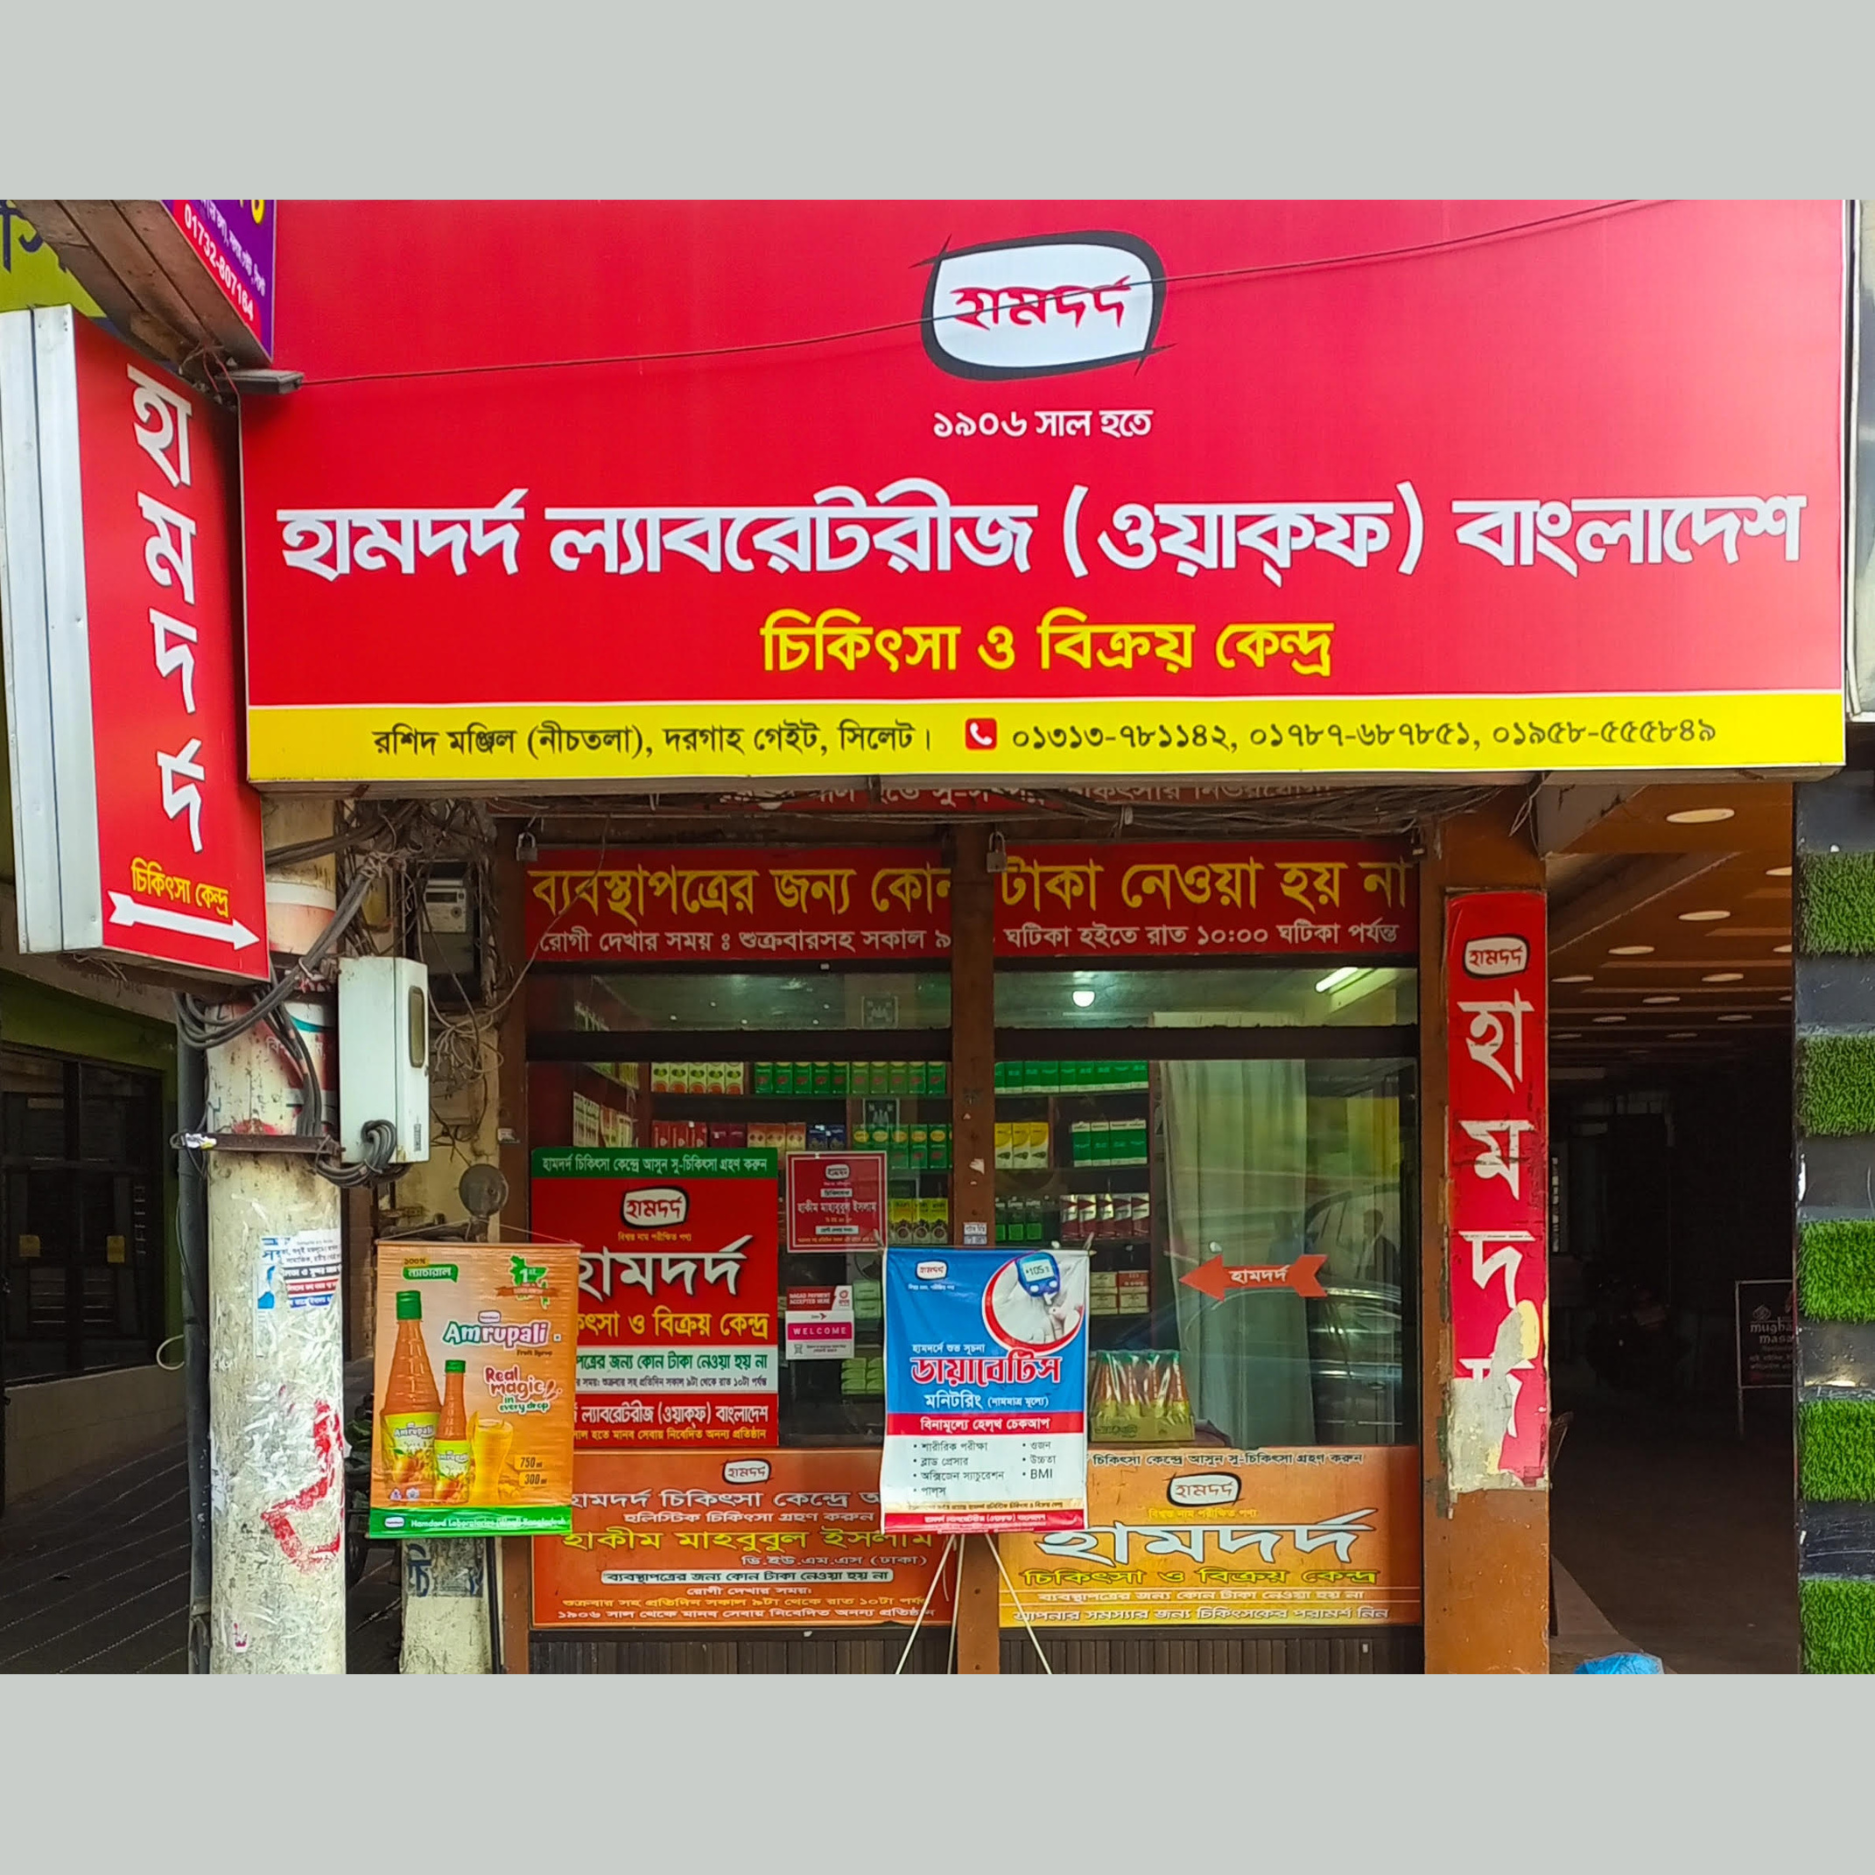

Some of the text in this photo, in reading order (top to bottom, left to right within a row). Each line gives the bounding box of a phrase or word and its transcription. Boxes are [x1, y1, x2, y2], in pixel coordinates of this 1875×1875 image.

[950, 275, 1131, 331] হামদর্দ
[933, 410, 1153, 438] ১৯০৬ সাল হতে
[277, 488, 529, 581] হামদর্দ
[545, 477, 1038, 574] ল্যাবরেটরীজ
[1452, 495, 1807, 577] বাংলাদেশ
[761, 607, 1334, 677] চিকিৎসা ও বিক্রয় কেন্দ্র
[371, 722, 440, 755] রশিদ
[446, 722, 518, 755] মঞ্জিল
[527, 720, 653, 760] (নীচতলা),
[662, 724, 745, 756] দরগাহ
[753, 719, 828, 756] গেইট,
[1012, 724, 1238, 753] ০১৩১৩-৭৮১১৪২,
[1250, 722, 1481, 751] ০১৭৮৭-৬৮৭৮৫১,
[1493, 719, 1716, 746] ০১৯৫৮-৫৫৫৮৪৯
[131, 857, 229, 918] চিকিৎসা কেন্দ্র
[528, 863, 759, 926] ব্যবস্থাপত্রের
[769, 868, 857, 915] জন্য
[1000, 856, 1411, 914] টাকা নেওয়া হয় না
[539, 926, 591, 953] রোগী
[599, 931, 658, 953] দেখার
[667, 931, 713, 953] সময়
[739, 930, 856, 954] শুক্রবারসহ
[861, 930, 926, 951] সকাল
[1004, 917, 1399, 950] ঘটিকা হইতে রাত ১০:০০ ঘটিকা পর্যন্ত
[1468, 946, 1523, 967] হামদর্দ
[626, 1197, 682, 1219] হামদর্দ
[1228, 1264, 1291, 1284] হামদর্দ
[628, 1305, 770, 1339] ও বিক্রয় কেন্দ্র
[793, 1326, 847, 1336] WELCOME
[444, 1322, 549, 1348] Amrupali
[608, 1351, 768, 1370] জন্য কোন টাকা নেওয়া হয় না
[910, 1346, 1063, 1386] ডায়াবেটিস
[485, 1367, 518, 1381] Real
[491, 1377, 545, 1398] magic
[500, 1402, 549, 1412] every drop
[923, 1389, 983, 1410] মনিটরিং
[581, 1400, 655, 1424] ল্যাবরেটরীজ
[715, 1405, 769, 1425] বাংলাদেশ
[920, 1416, 970, 1434] বিনামূল্যে
[1006, 1418, 1050, 1430] চেকআপ
[921, 1440, 988, 1452] শারীরিক পরীক্ষা
[520, 1457, 536, 1468] 750
[1093, 1453, 1363, 1466] চিকিৎসা কেন্দ্রে আসুন সু-চিকিৎসা গ্রহণ করুন
[524, 1474, 540, 1485] 300
[728, 1465, 767, 1479] হামদর্দ
[1030, 1469, 1053, 1480] BMI
[571, 1488, 653, 1508] হামদর্দ
[660, 1488, 764, 1508] চিকিৎসা
[773, 1491, 851, 1508] কেন্দ্রে
[1175, 1482, 1234, 1498] হামদর্দ
[624, 1511, 874, 1523] হলিস্টিক চিকিৎসা গ্রহণ করুন
[561, 1526, 664, 1551] হাকীম
[674, 1531, 810, 1553] মাহবুবুল
[820, 1525, 932, 1548] ইসলাম
[1036, 1508, 1379, 1567] হামদর্দ
[870, 1555, 927, 1566] (ঢাকা)
[691, 1572, 722, 1582] জন্য
[726, 1572, 759, 1582] কোন
[763, 1571, 796, 1581] টাকা
[801, 1572, 843, 1581] নেওয়া
[846, 1572, 868, 1581] হয়
[872, 1571, 889, 1580] না
[1019, 1566, 1381, 1585] চিকিৎসা ও বিক্রয় কেন্দ্র
[1154, 1609, 1191, 1619] জন্য
[1197, 1607, 1289, 1619] চিকিৎসকের
[1357, 1606, 1389, 1619] নিন
